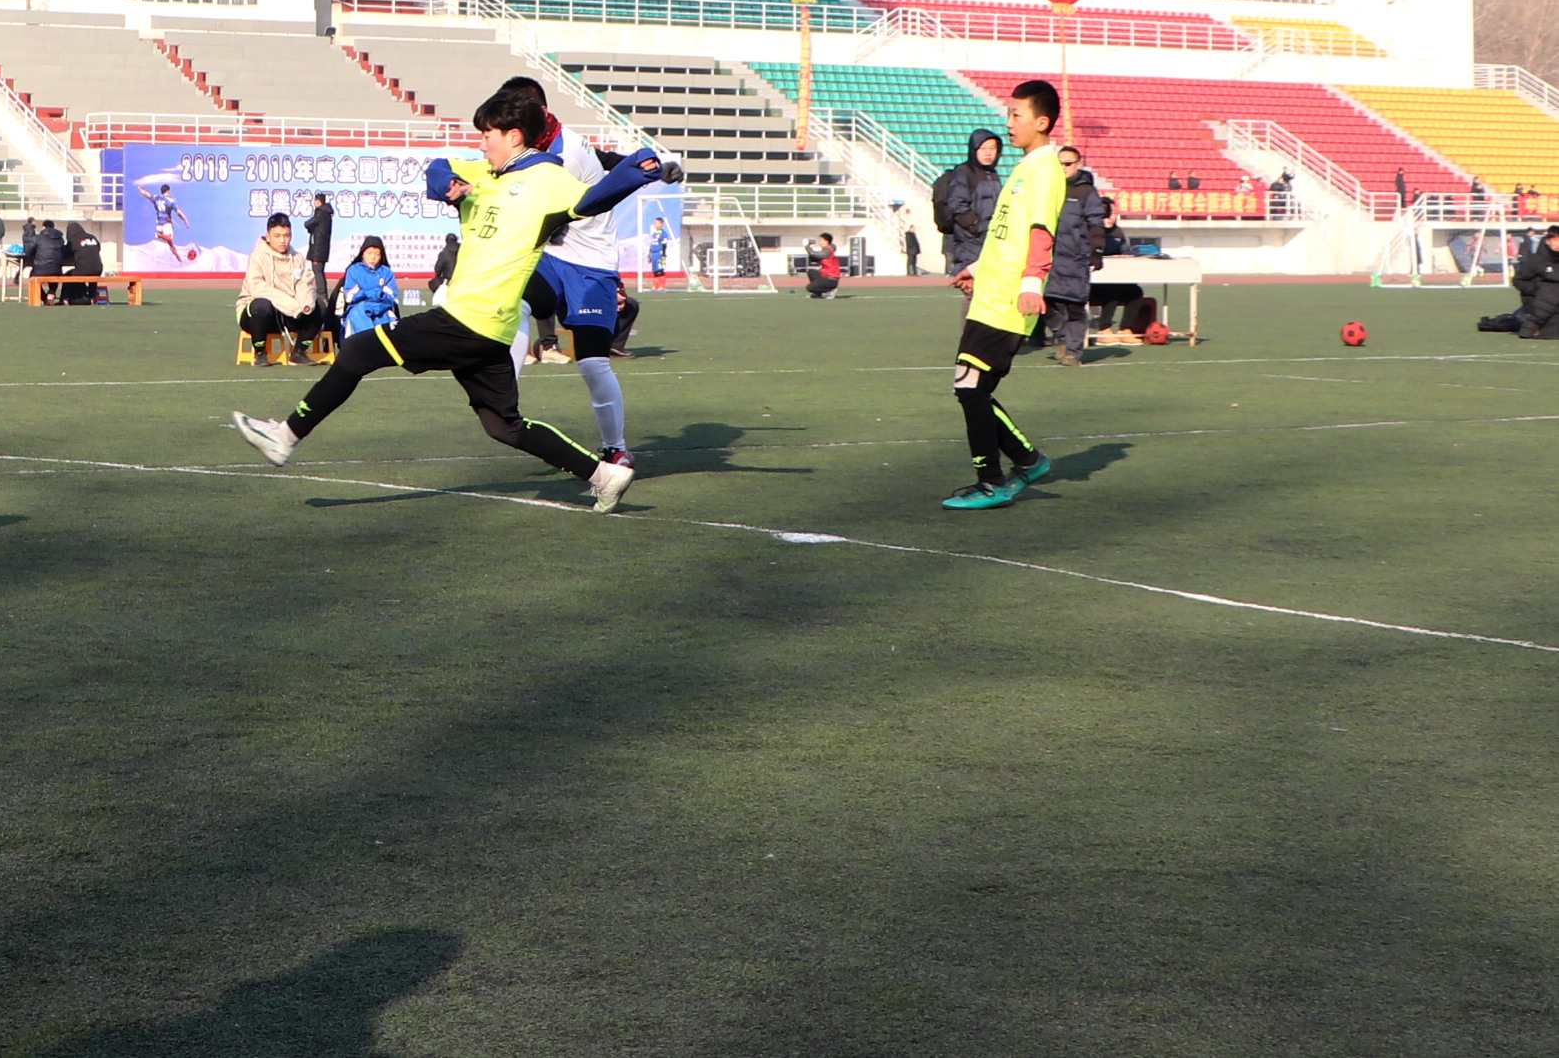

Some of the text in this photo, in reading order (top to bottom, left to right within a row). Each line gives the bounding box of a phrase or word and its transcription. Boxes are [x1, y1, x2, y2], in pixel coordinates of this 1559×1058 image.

[248, 188, 460, 219] 暨黑龙省青少年雪地
